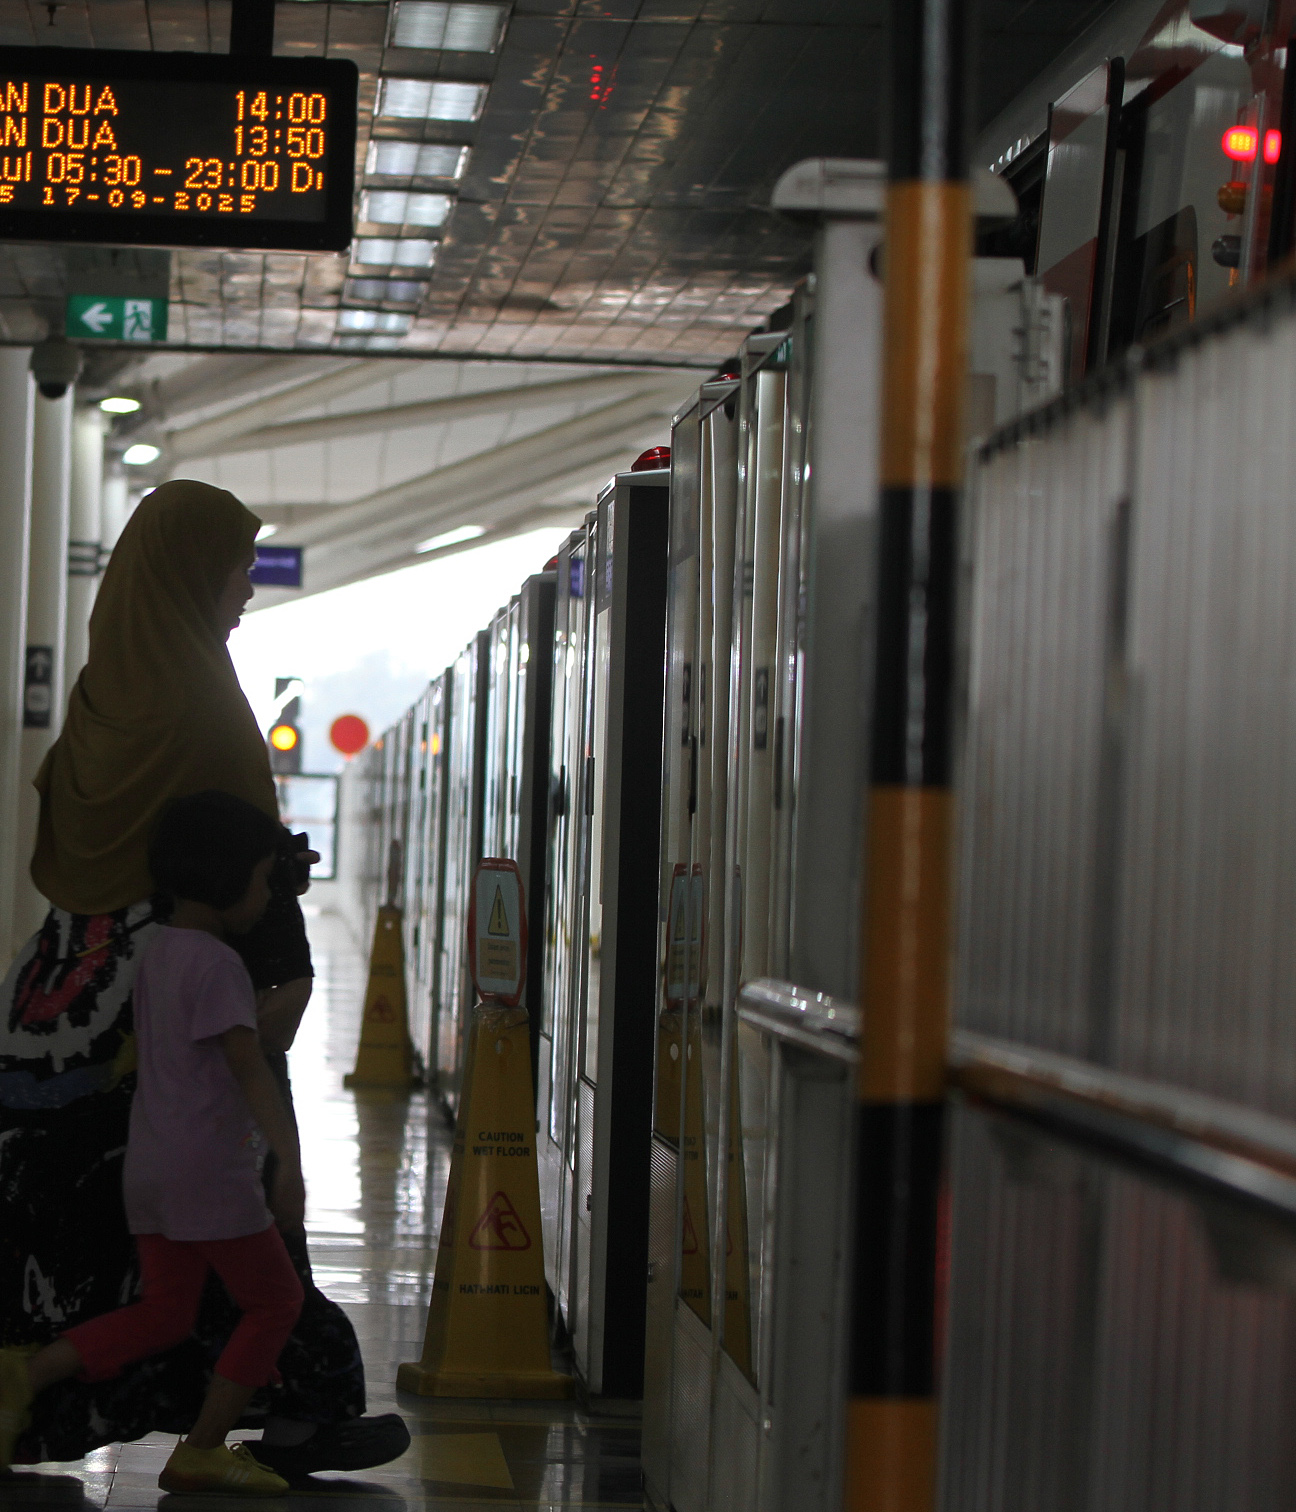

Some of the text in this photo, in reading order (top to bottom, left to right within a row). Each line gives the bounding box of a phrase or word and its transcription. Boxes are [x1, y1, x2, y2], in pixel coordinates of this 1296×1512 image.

[44, 83, 119, 117] DUA
[236, 91, 327, 125] 14:00
[42, 118, 119, 152] DUA
[234, 125, 326, 160] 13:50
[46, 152, 143, 187] 05:30
[184, 157, 281, 193] 23:00
[42, 186, 257, 214] 17-09-2025
[479, 1132, 523, 1142] CAUTION
[473, 1146, 530, 1157] WET FLOOR
[459, 1284, 540, 1295] HATI-HATI LICIN
